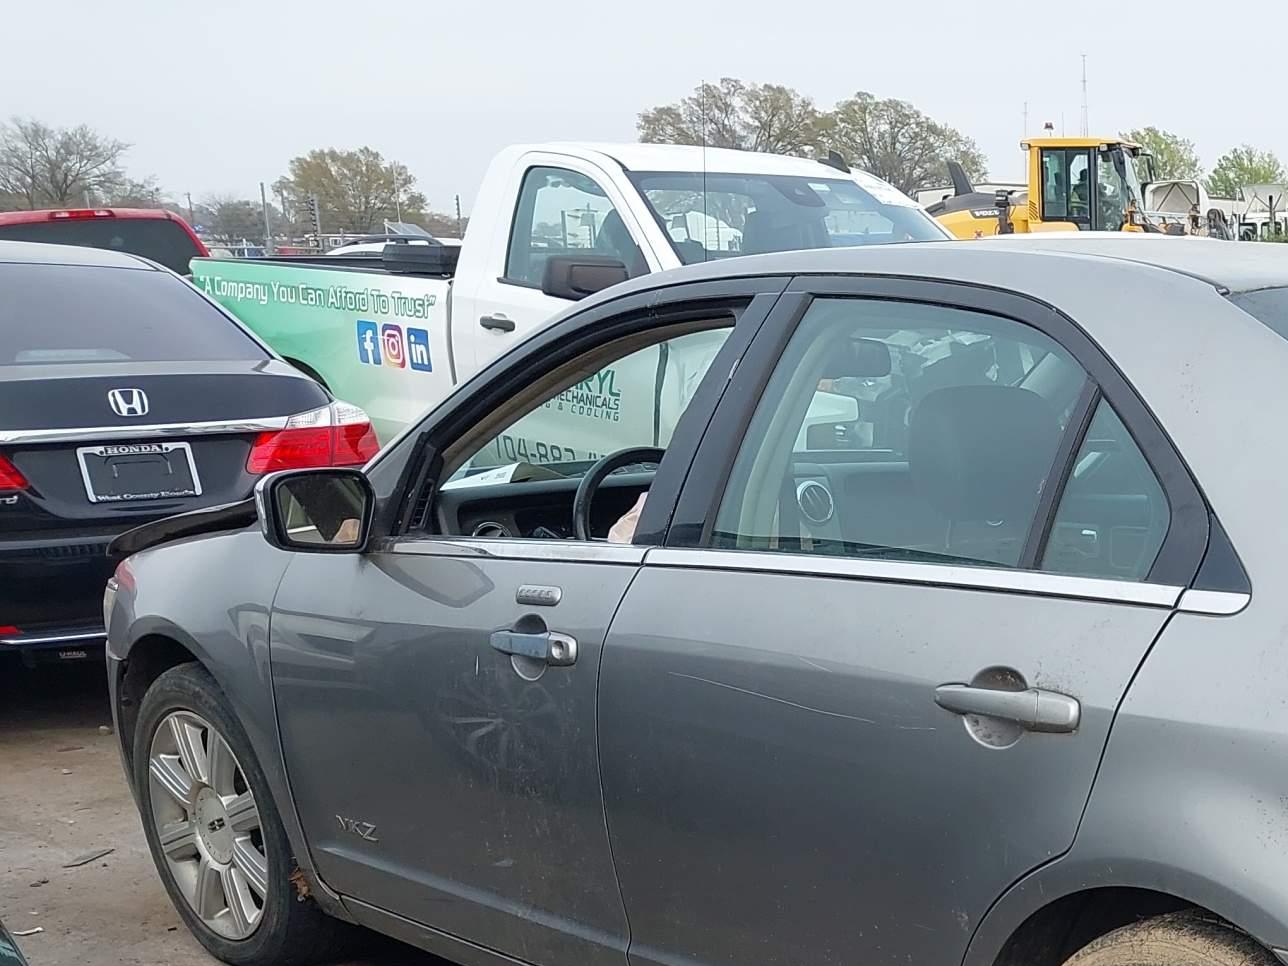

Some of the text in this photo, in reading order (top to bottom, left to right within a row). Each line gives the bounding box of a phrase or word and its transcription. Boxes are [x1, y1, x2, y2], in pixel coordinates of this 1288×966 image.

[214, 276, 268, 305] Company
[271, 281, 296, 303] You
[299, 286, 325, 306] Can
[328, 288, 368, 312] Afford
[371, 290, 389, 314] To
[570, 404, 620, 422] COOLING
[105, 444, 162, 455] HONDA
